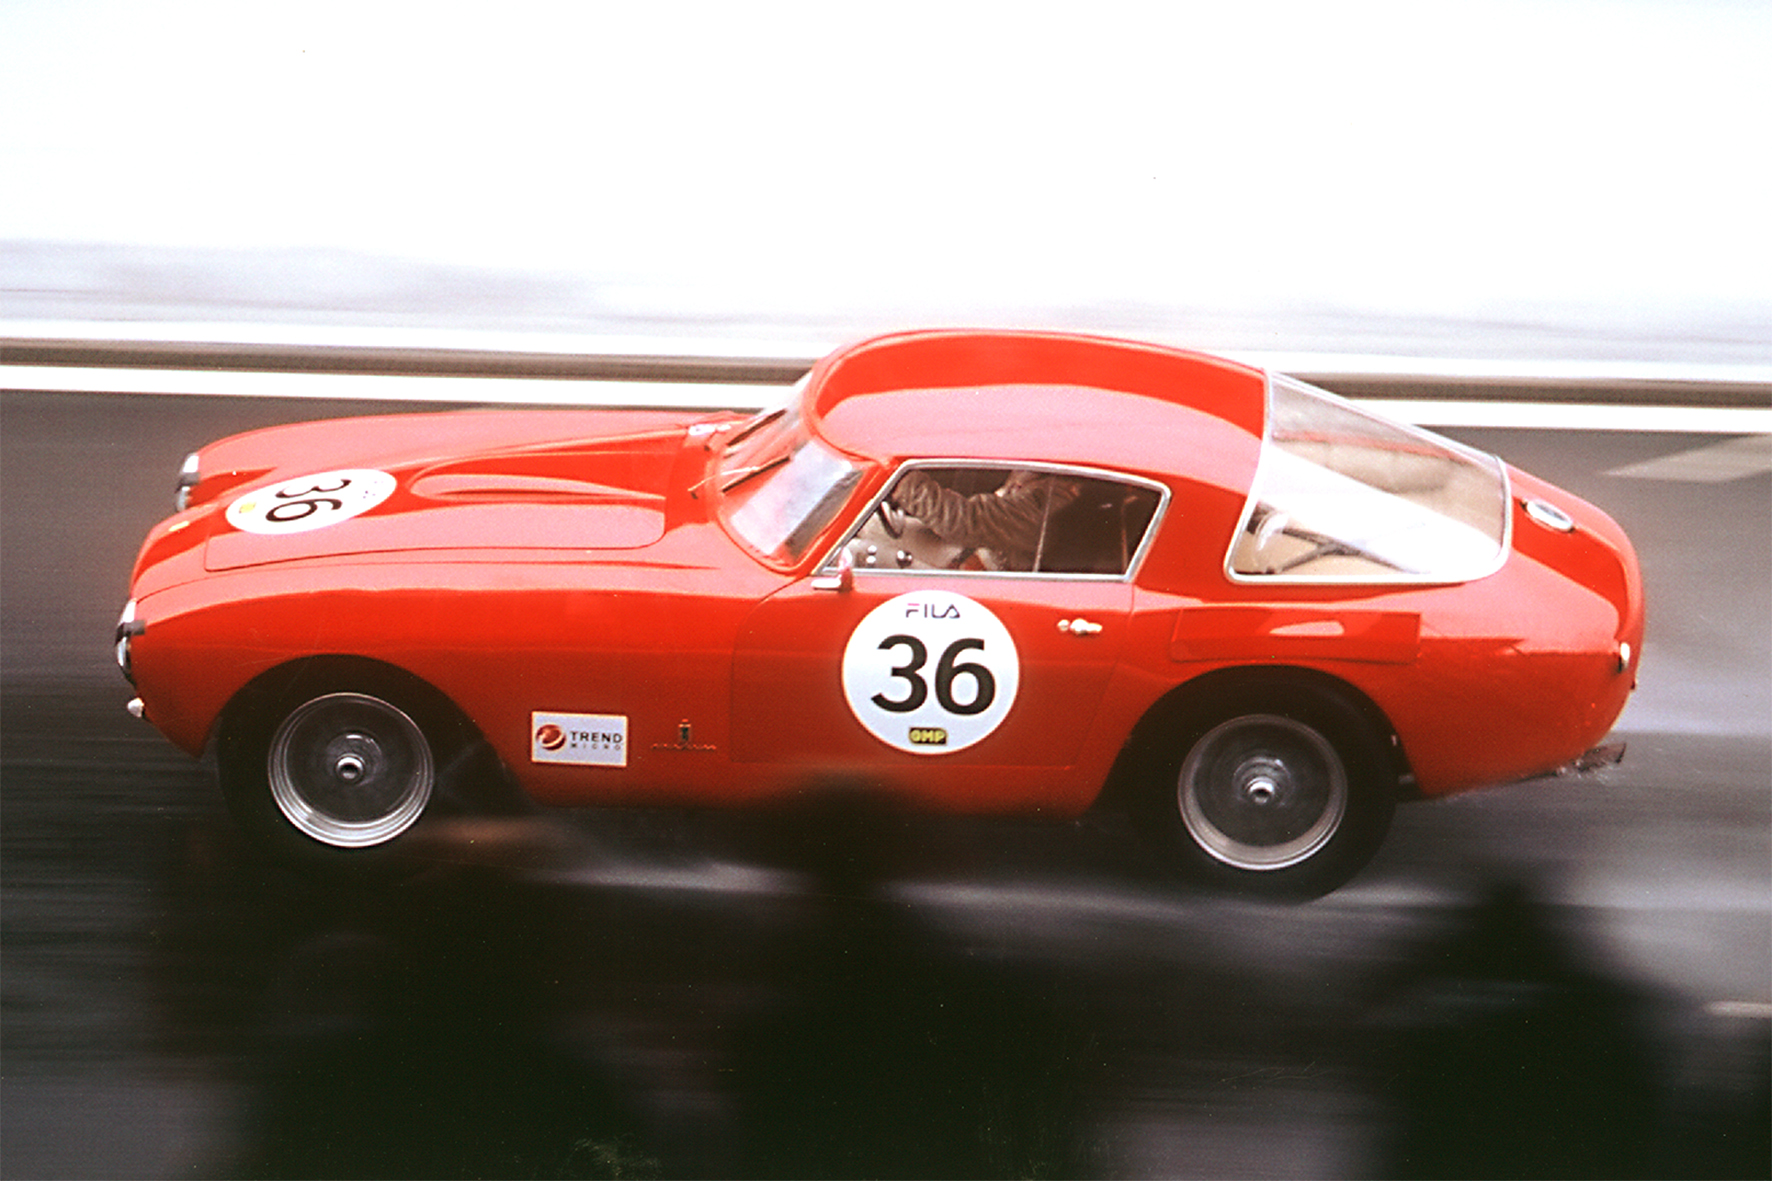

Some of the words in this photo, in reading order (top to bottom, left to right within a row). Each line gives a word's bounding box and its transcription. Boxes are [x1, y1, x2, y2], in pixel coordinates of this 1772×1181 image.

[265, 479, 352, 523] 36
[905, 603, 961, 619] FILA
[870, 634, 996, 716] 36
[570, 731, 623, 743] TREND
[910, 729, 946, 743] OMP
